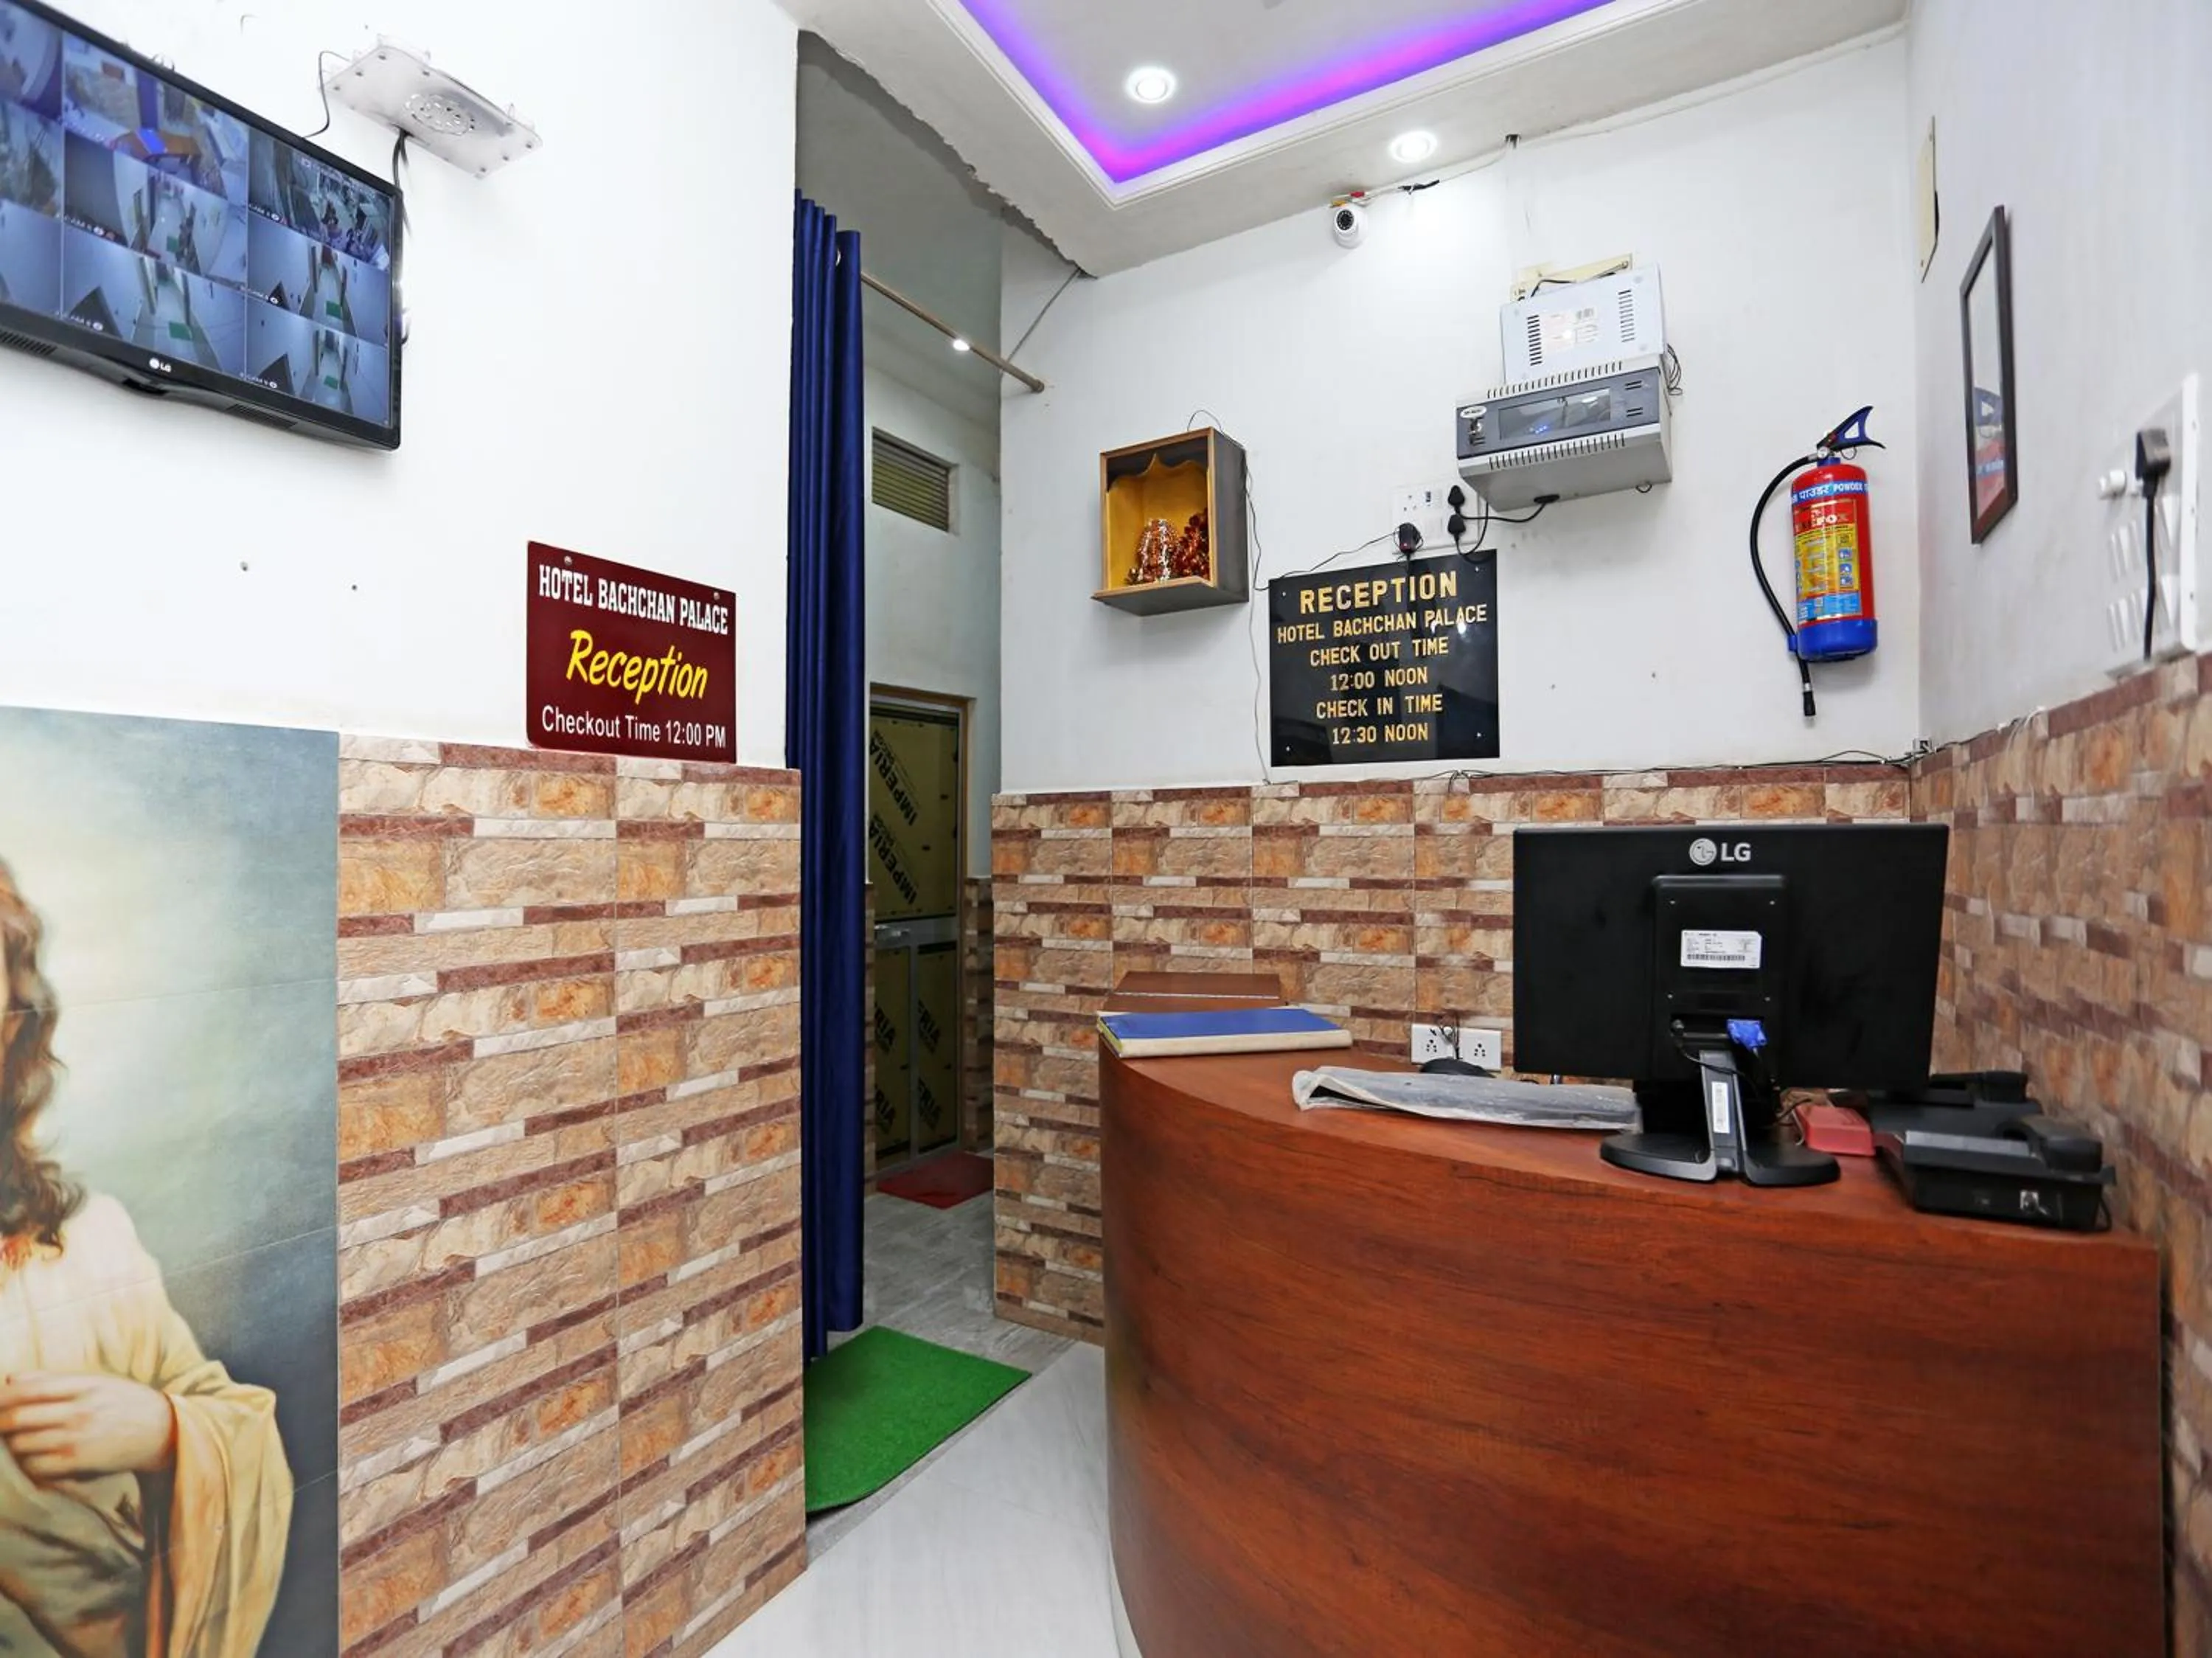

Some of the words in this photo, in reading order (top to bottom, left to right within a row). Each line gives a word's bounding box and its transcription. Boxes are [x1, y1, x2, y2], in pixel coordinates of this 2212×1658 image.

[160, 363, 172, 372] LG
[539, 564, 593, 606] HOTEL
[598, 577, 675, 624] BACHCHAN
[680, 597, 728, 635] PALACE
[1300, 570, 1458, 614] RECEPTION
[1278, 622, 1324, 643] HOTEL
[1333, 612, 1416, 638] BACHCHAN
[1425, 604, 1487, 628] PALACE
[1310, 646, 1361, 666] CHECK
[1369, 641, 1400, 661] OUT
[1412, 637, 1449, 657] TIME
[566, 629, 708, 705] Reception
[1329, 671, 1375, 691] 12:00
[1385, 667, 1427, 687] NOON
[1316, 698, 1368, 719] CHECK
[1377, 697, 1393, 715] IN
[1405, 694, 1443, 713] TIME
[542, 705, 620, 738] Checkout
[625, 715, 661, 742] Time
[666, 720, 701, 746] 12:00
[706, 724, 726, 748] PM
[1332, 726, 1377, 744] 12:30
[1385, 723, 1428, 741] NOON
[1720, 842, 1751, 861] LG
